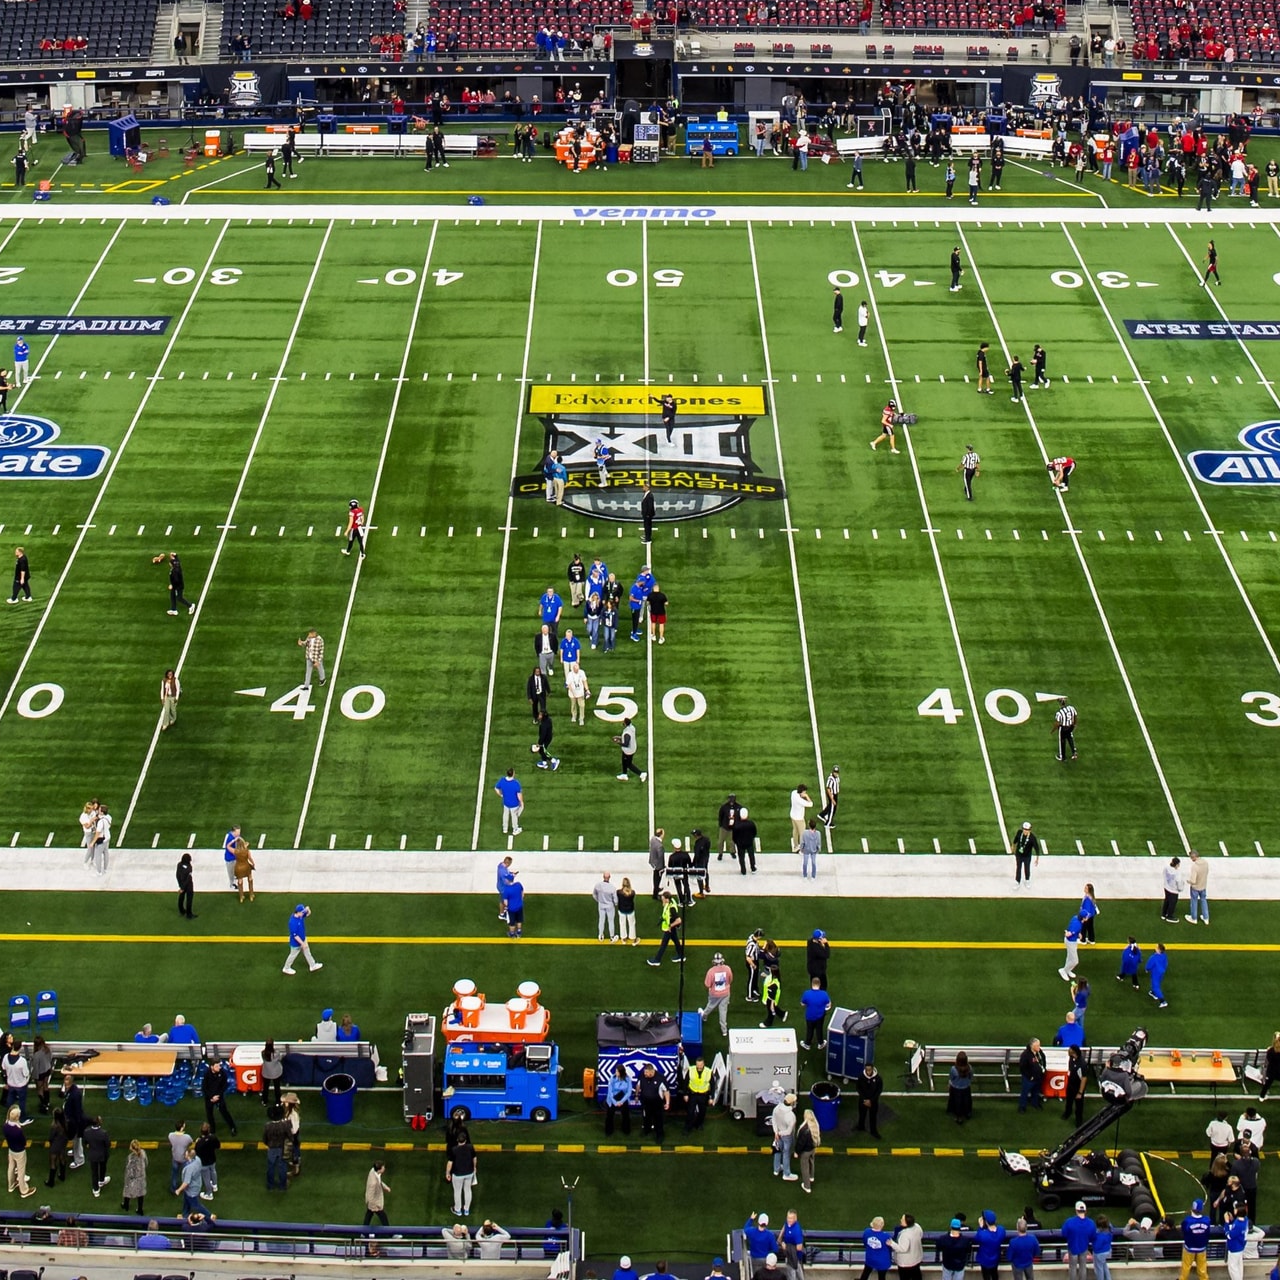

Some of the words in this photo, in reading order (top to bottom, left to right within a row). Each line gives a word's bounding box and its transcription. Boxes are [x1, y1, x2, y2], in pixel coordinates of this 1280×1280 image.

[573, 208, 716, 218] venmo
[37, 319, 164, 332] STADIUM
[1134, 323, 1201, 336] AT&T
[566, 471, 727, 482] FOOTBALL
[520, 479, 776, 493] CAMPIONSHIP
[270, 685, 385, 720] 40
[593, 686, 708, 722] 50
[916, 688, 1032, 724] 40
